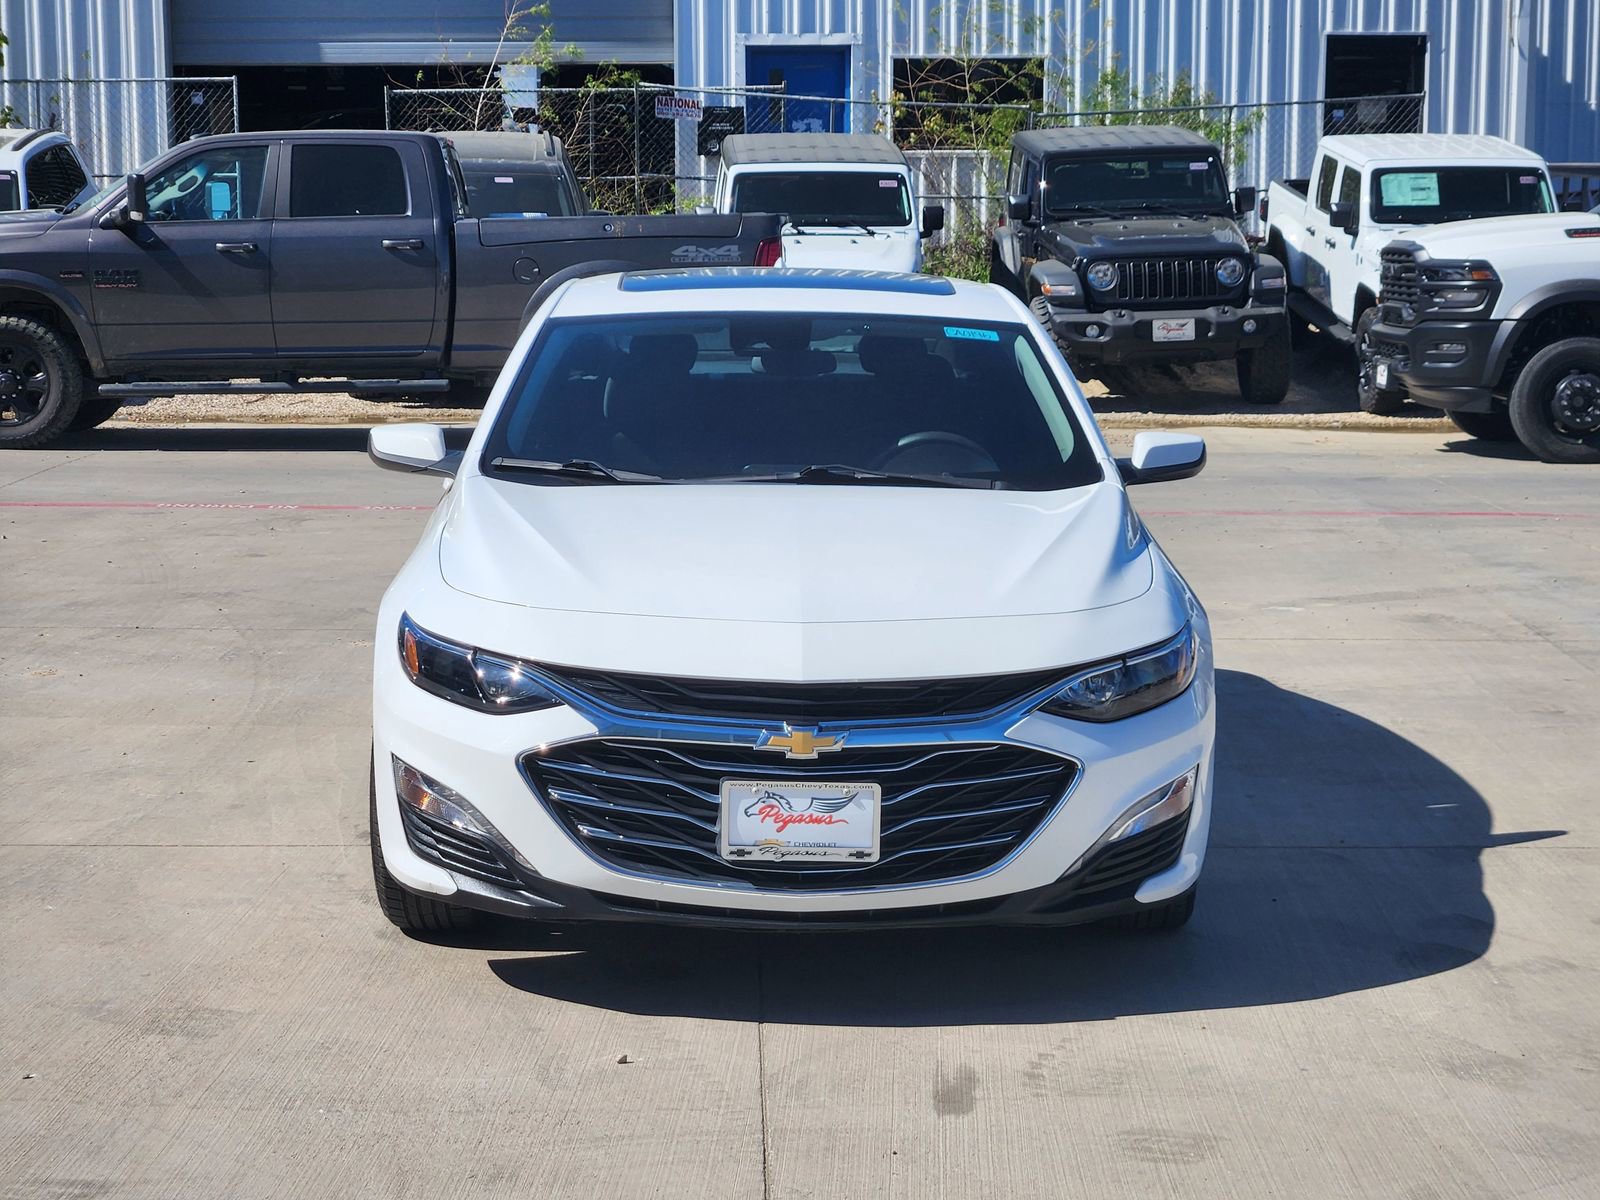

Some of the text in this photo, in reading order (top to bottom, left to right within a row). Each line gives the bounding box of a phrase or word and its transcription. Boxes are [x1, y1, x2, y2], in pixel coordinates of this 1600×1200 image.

[656, 97, 701, 110] NATIONAL
[671, 245, 741, 257] 4x4
[729, 782, 874, 790] www.PegasusChevyTexas.com
[758, 803, 849, 833] Pegasus
[759, 847, 842, 859] Pegasus
